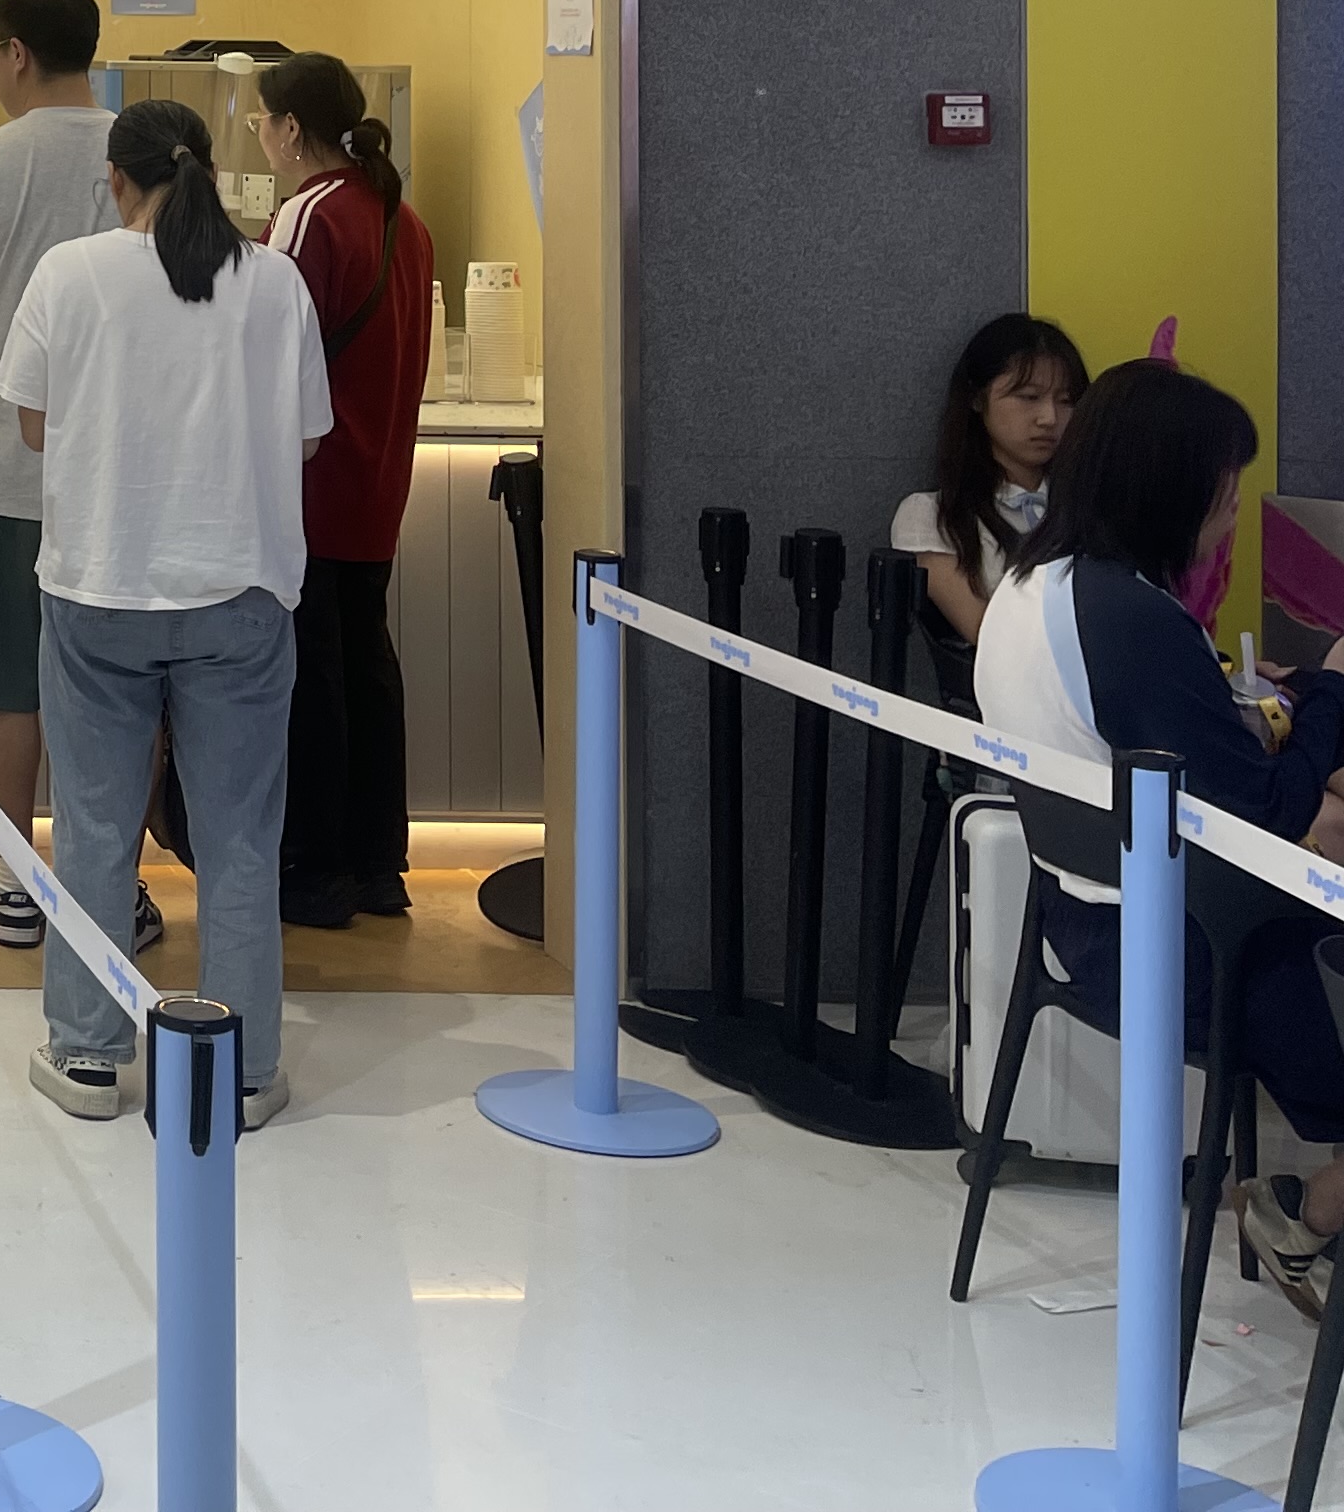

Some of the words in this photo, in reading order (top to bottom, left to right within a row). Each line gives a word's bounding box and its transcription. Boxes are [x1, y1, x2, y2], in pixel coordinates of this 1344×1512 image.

[710, 636, 751, 668] Yoajung
[832, 682, 880, 718] Yoajung
[973, 733, 1028, 771] Yoajung
